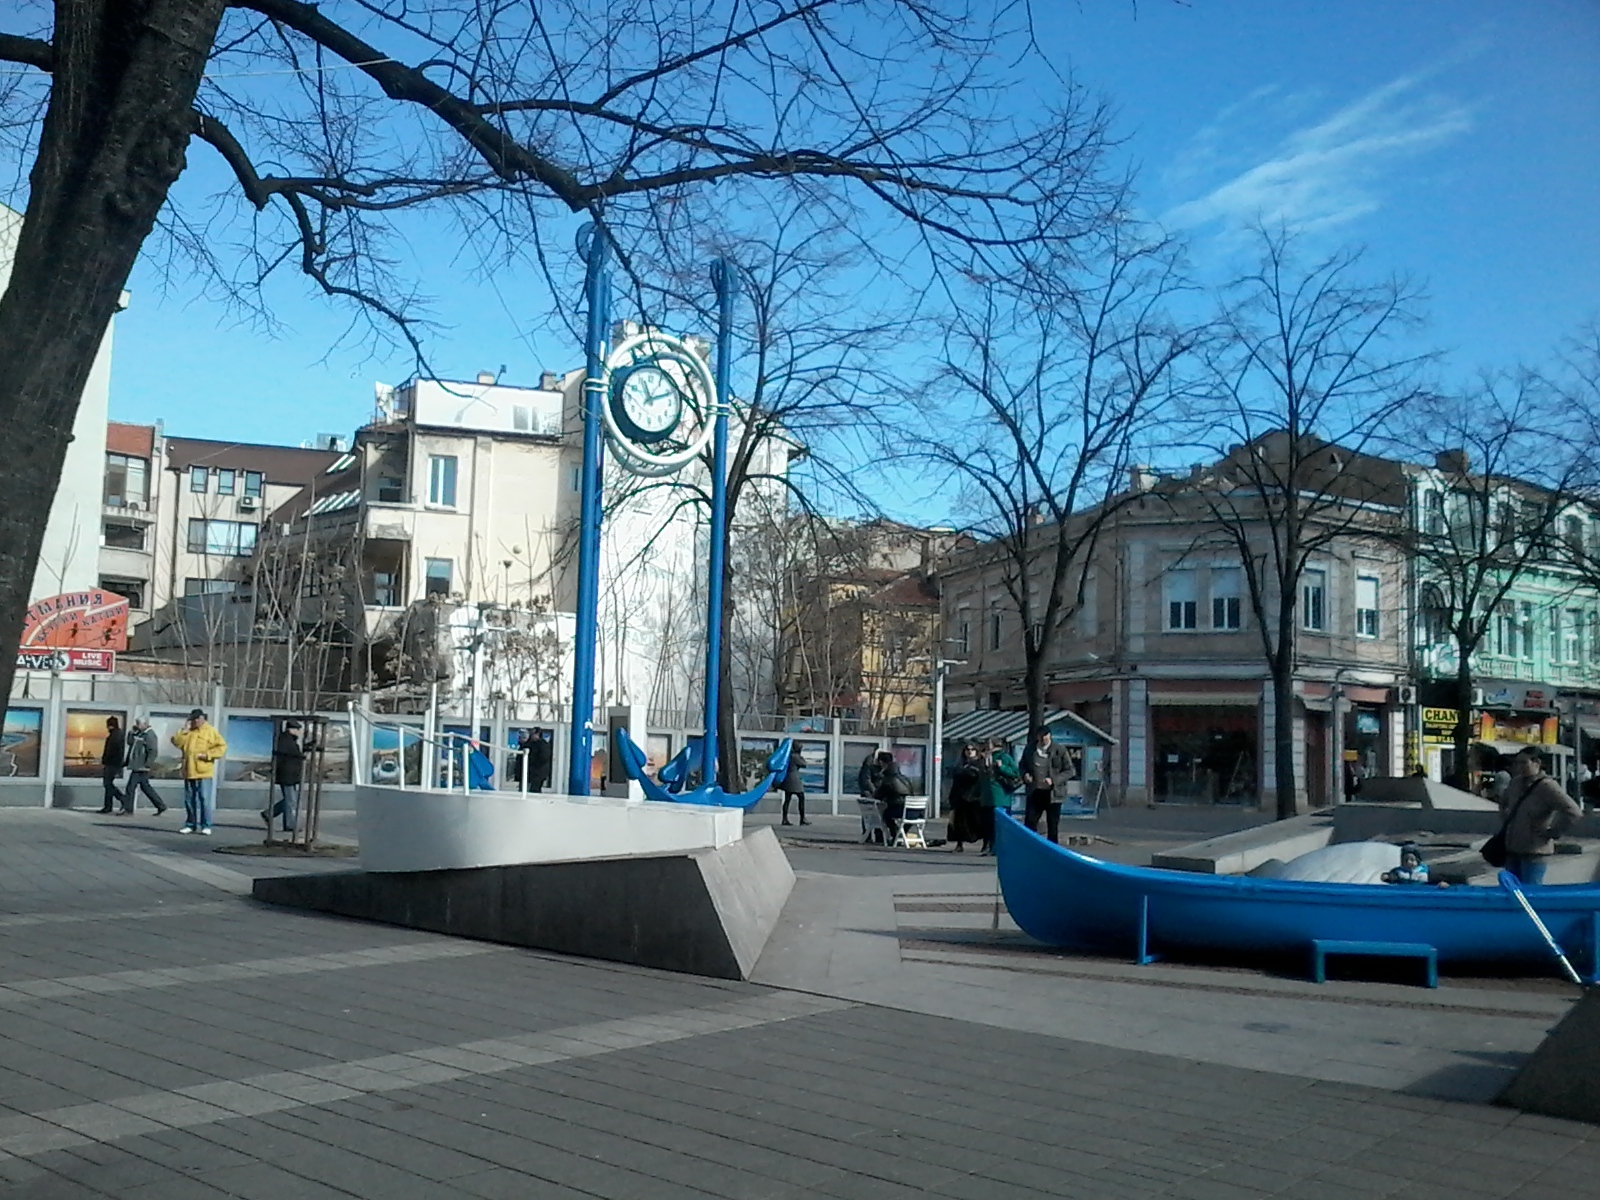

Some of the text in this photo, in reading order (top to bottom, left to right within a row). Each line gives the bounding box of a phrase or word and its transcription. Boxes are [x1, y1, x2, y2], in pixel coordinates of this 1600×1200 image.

[82, 652, 102, 660] LIVE
[73, 658, 102, 667] MUSIC
[1425, 709, 1458, 722] CHAN
